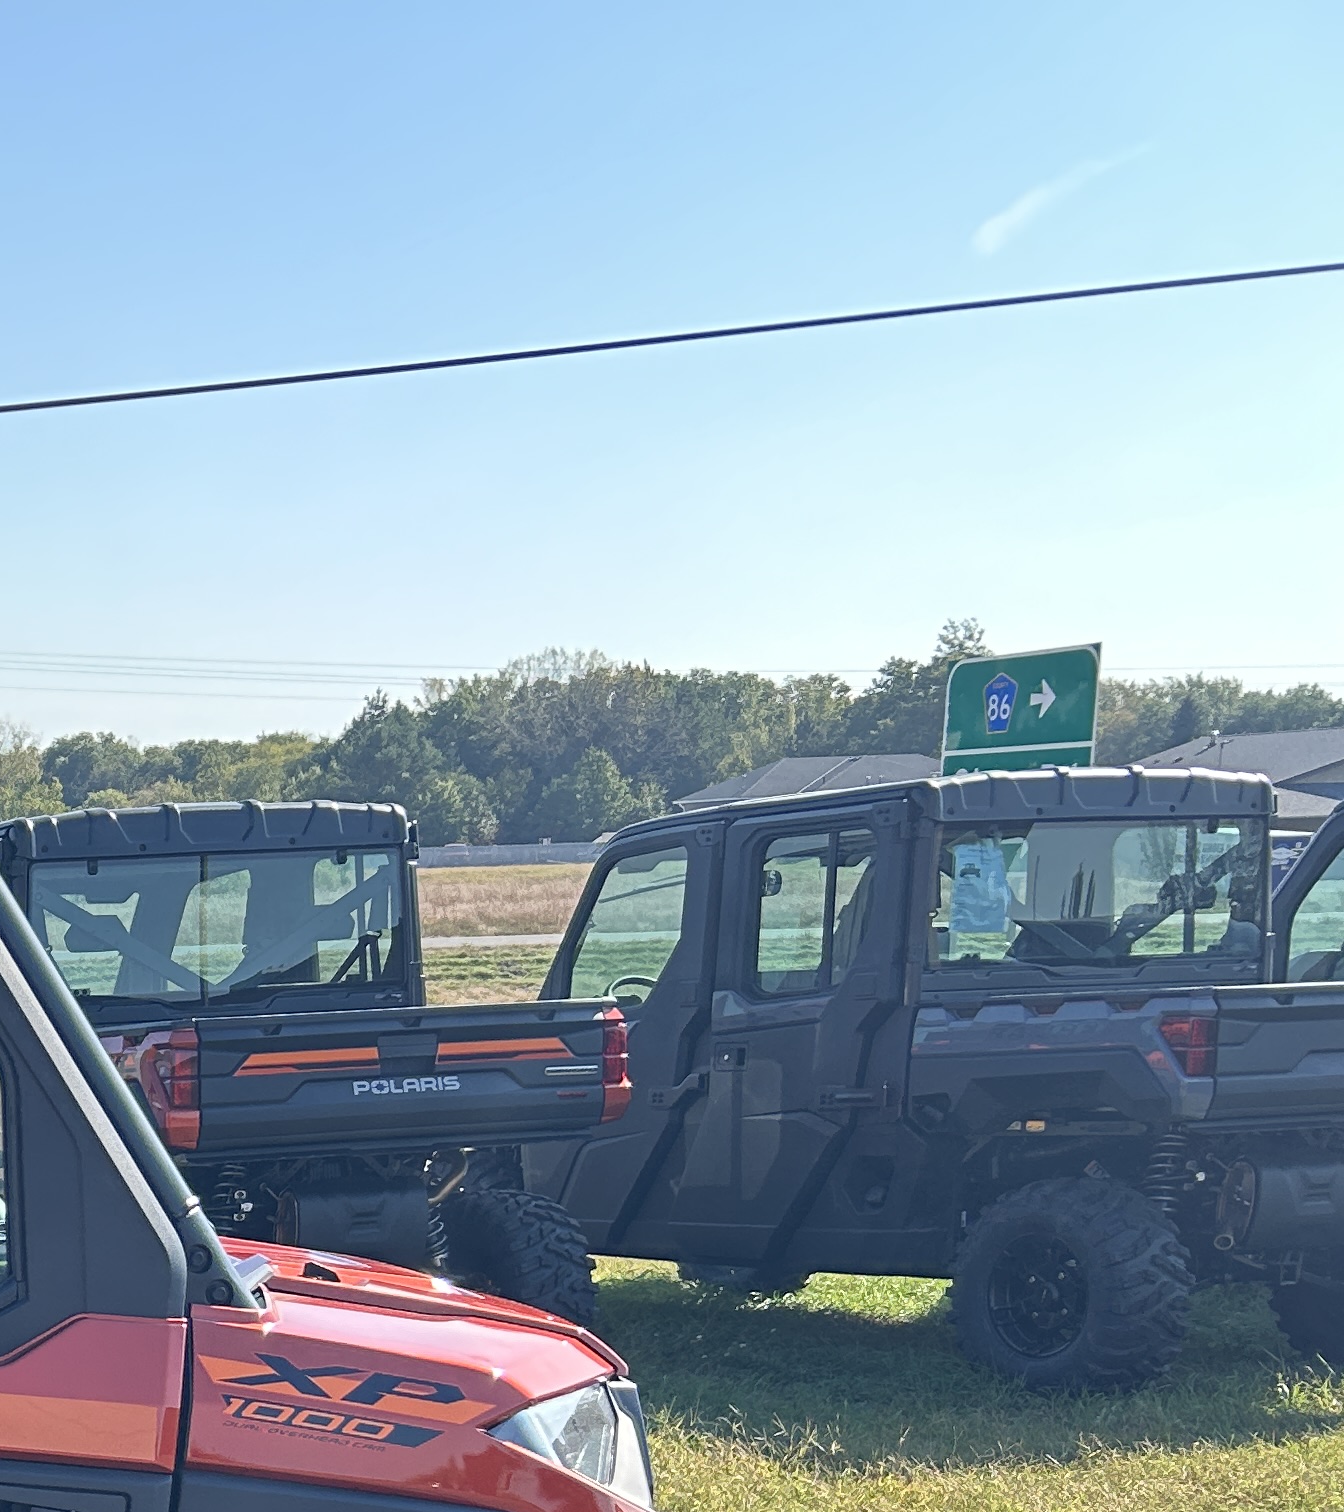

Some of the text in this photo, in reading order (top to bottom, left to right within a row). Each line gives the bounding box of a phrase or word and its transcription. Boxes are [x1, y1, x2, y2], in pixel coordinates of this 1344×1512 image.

[987, 694, 1010, 721] 86
[352, 1075, 461, 1096] POLARIS
[216, 1352, 466, 1405] XP
[223, 1397, 395, 1440] 1000
[222, 1420, 386, 1452] DUAL OVERHEAD CAM
